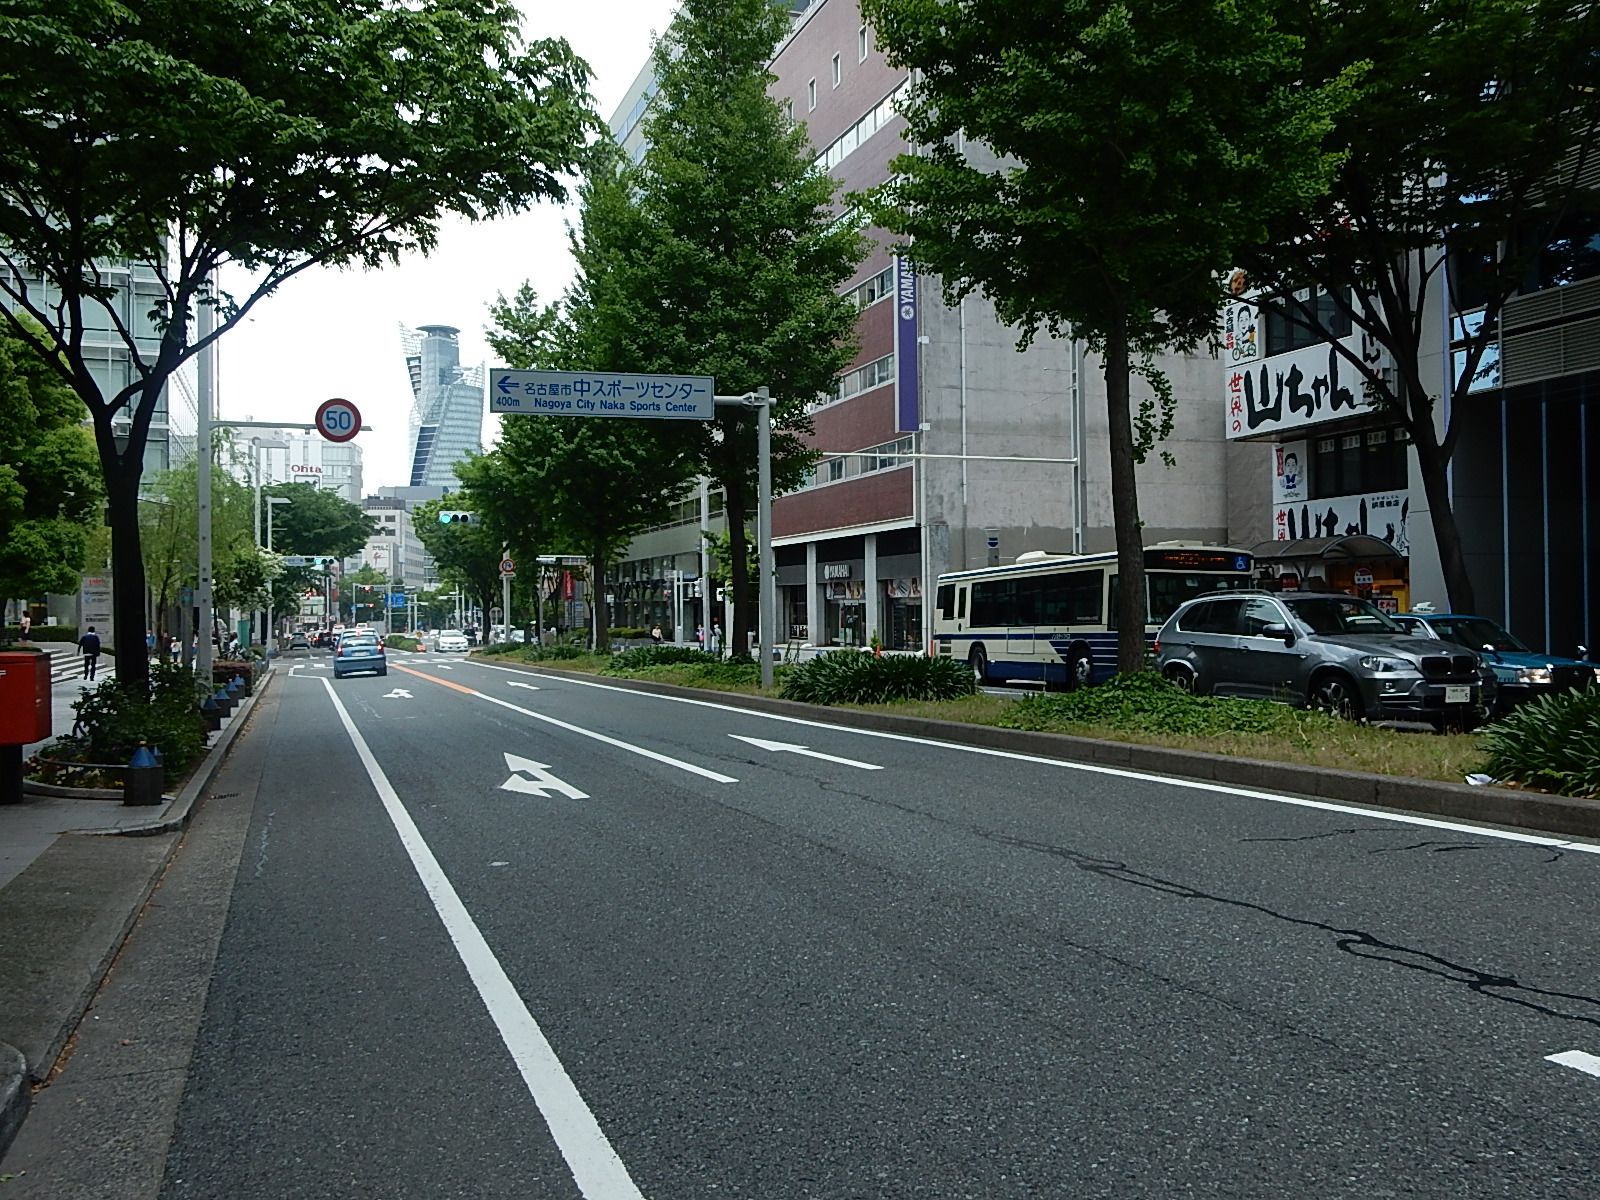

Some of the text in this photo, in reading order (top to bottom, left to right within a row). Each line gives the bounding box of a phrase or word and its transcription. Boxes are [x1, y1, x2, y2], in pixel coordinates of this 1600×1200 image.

[524, 378, 706, 400] 名古屋市中スポーツセンター
[1244, 344, 1366, 430] 山ちゃん
[496, 397, 520, 407] 400m
[534, 398, 697, 412] Nagoya City Naka Sports Center
[1228, 372, 1243, 432] 世界の
[326, 410, 351, 430] 50
